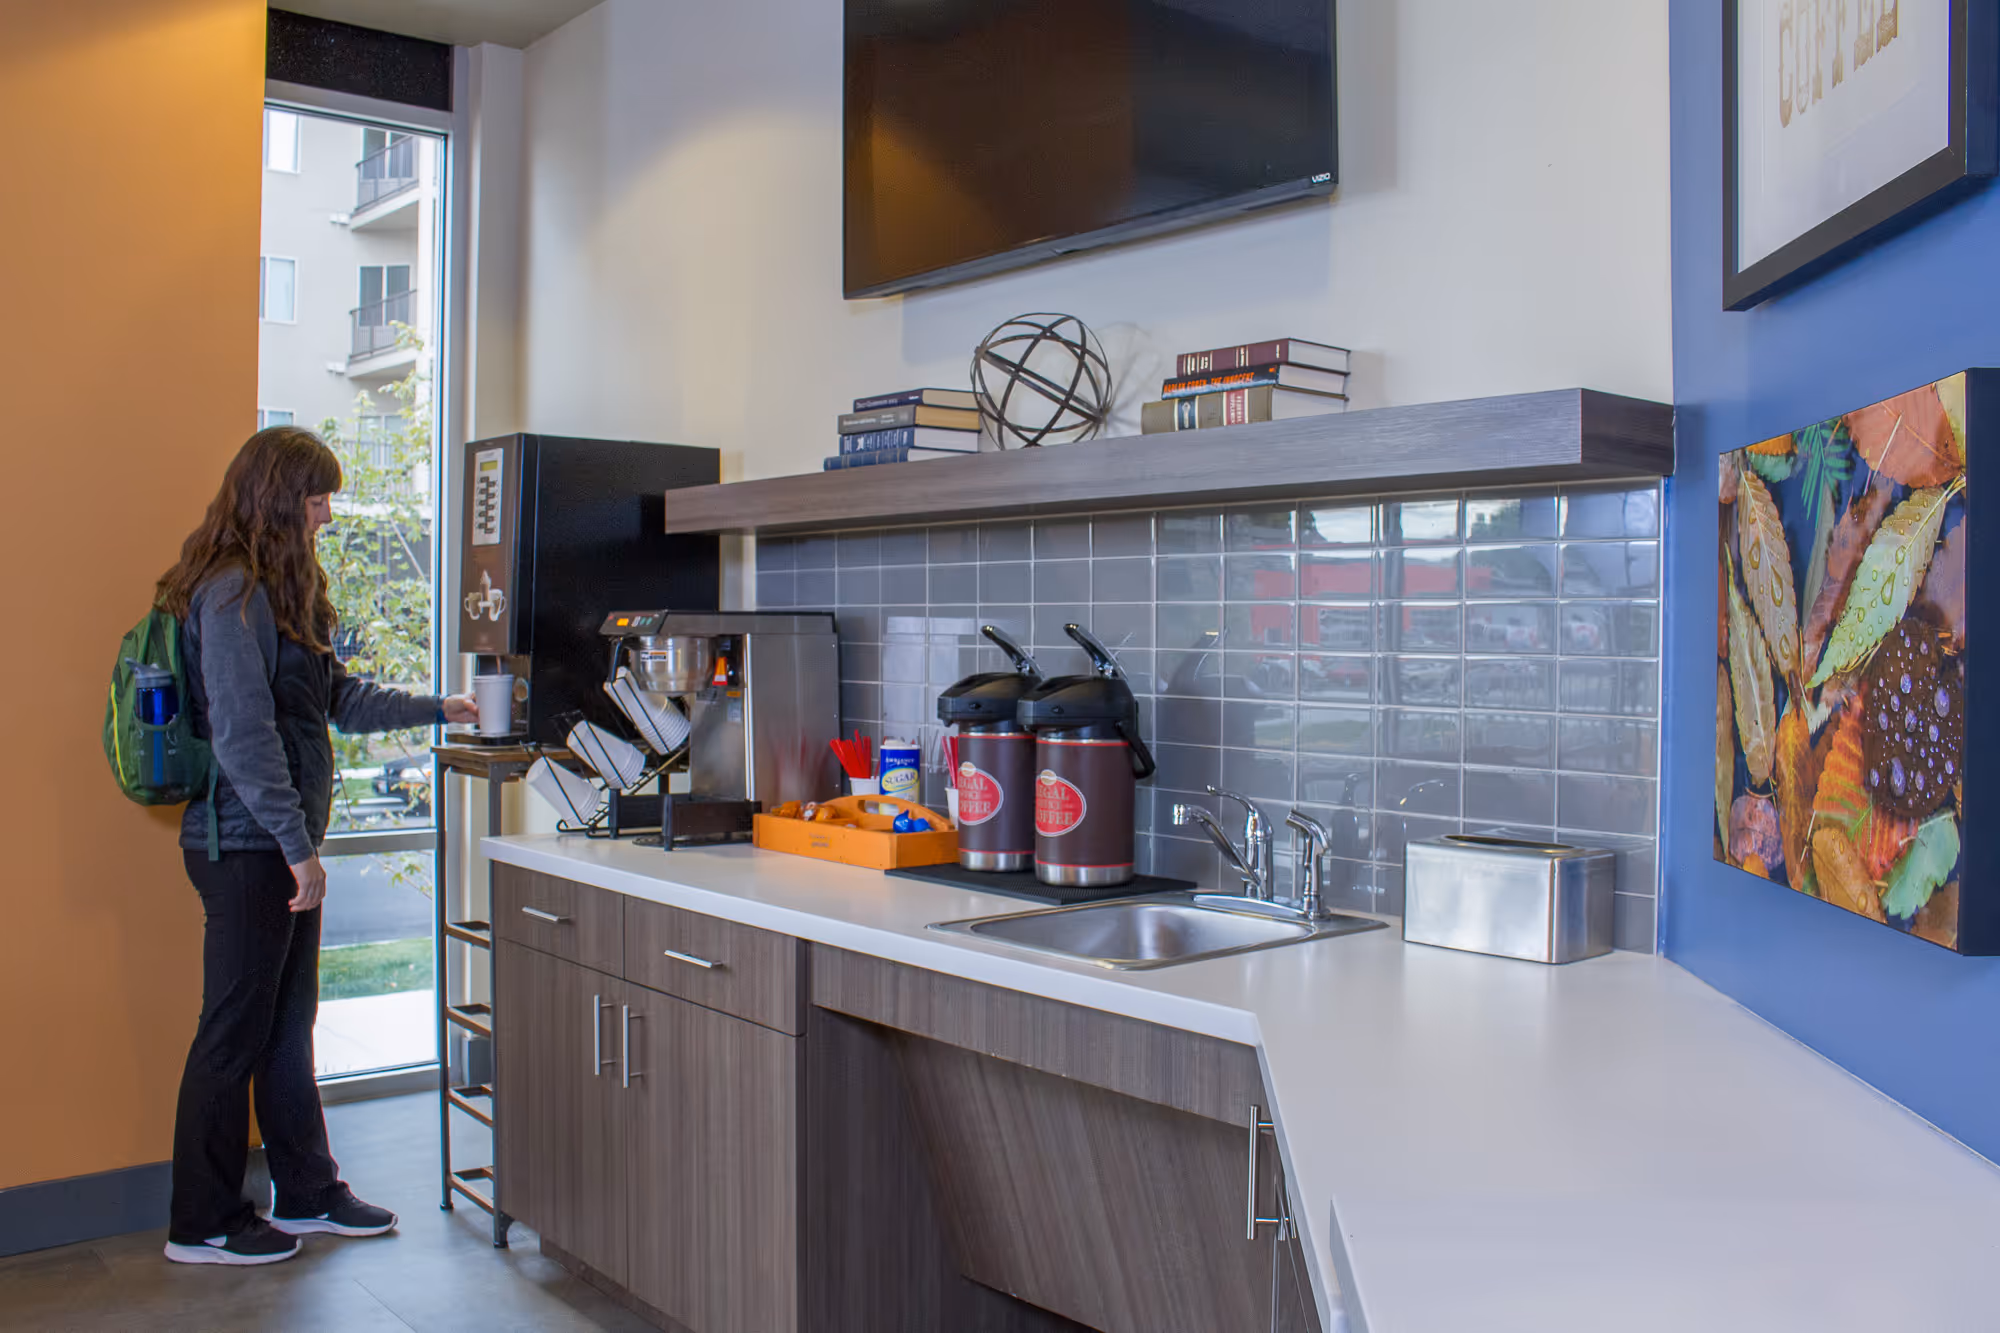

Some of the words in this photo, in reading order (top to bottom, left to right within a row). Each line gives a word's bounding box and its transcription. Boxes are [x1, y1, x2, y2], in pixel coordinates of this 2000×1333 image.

[1311, 172, 1331, 184] VIZIO
[884, 770, 916, 786] SUGAR
[958, 775, 988, 791] EGAL
[1037, 784, 1070, 801] EGAL
[959, 799, 992, 815] OFFEE
[1037, 809, 1073, 826] OFFEE
